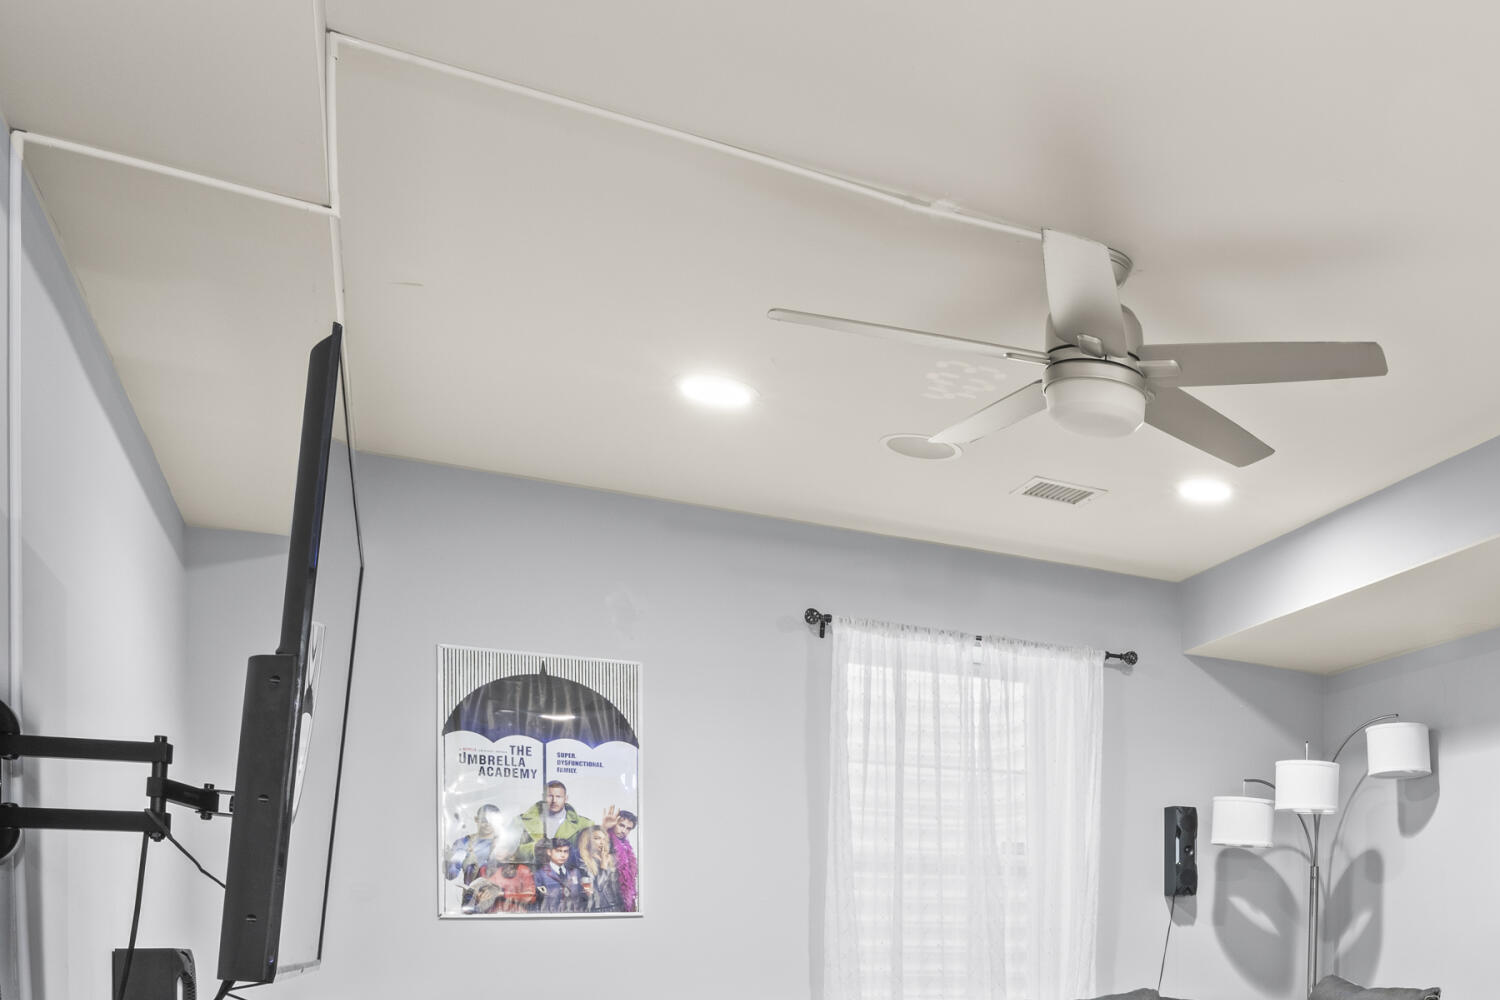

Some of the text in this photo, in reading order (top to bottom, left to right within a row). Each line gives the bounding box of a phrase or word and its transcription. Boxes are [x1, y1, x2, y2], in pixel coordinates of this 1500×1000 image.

[509, 744, 532, 757] THE
[458, 752, 526, 768] UMBRELLA
[478, 766, 538, 780] ACADEMY
